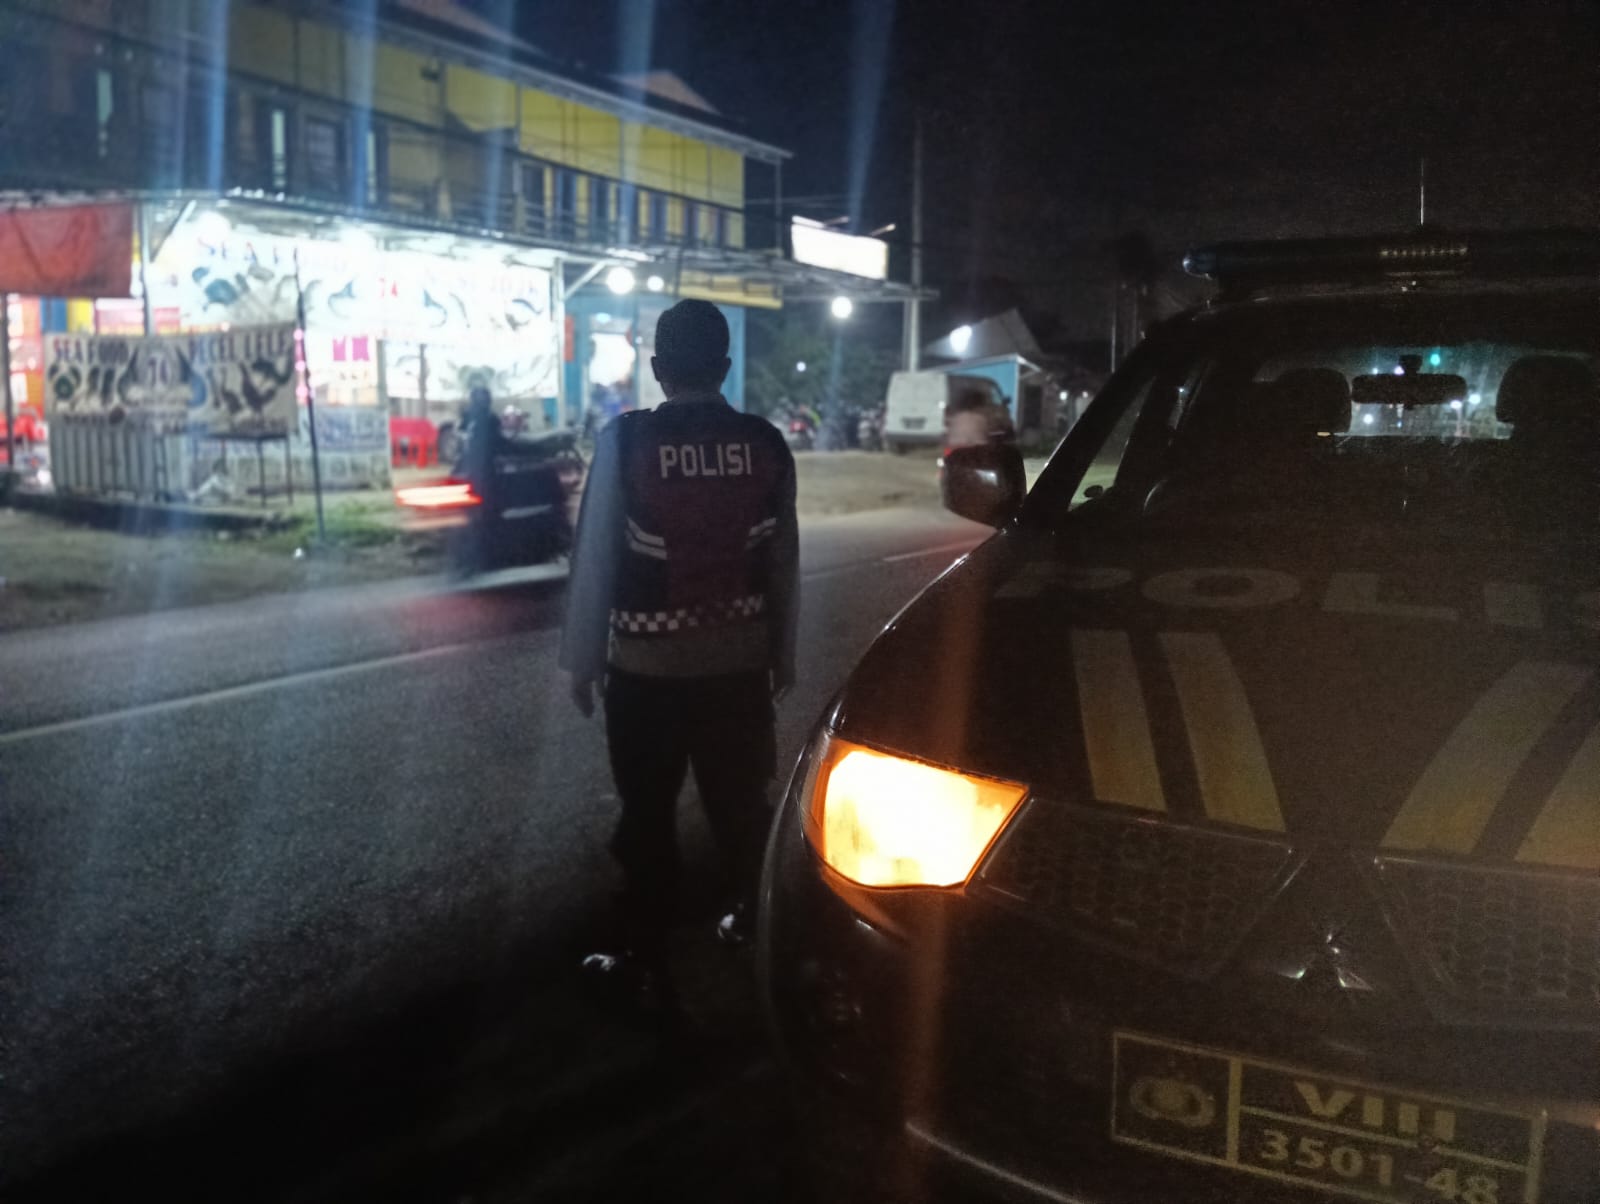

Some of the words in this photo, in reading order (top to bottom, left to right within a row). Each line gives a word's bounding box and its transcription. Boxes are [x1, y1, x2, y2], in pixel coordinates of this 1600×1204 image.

[659, 443, 752, 479] POLISI
[1294, 1081, 1456, 1144] VIII
[1259, 1127, 1498, 1204] 3501-48
